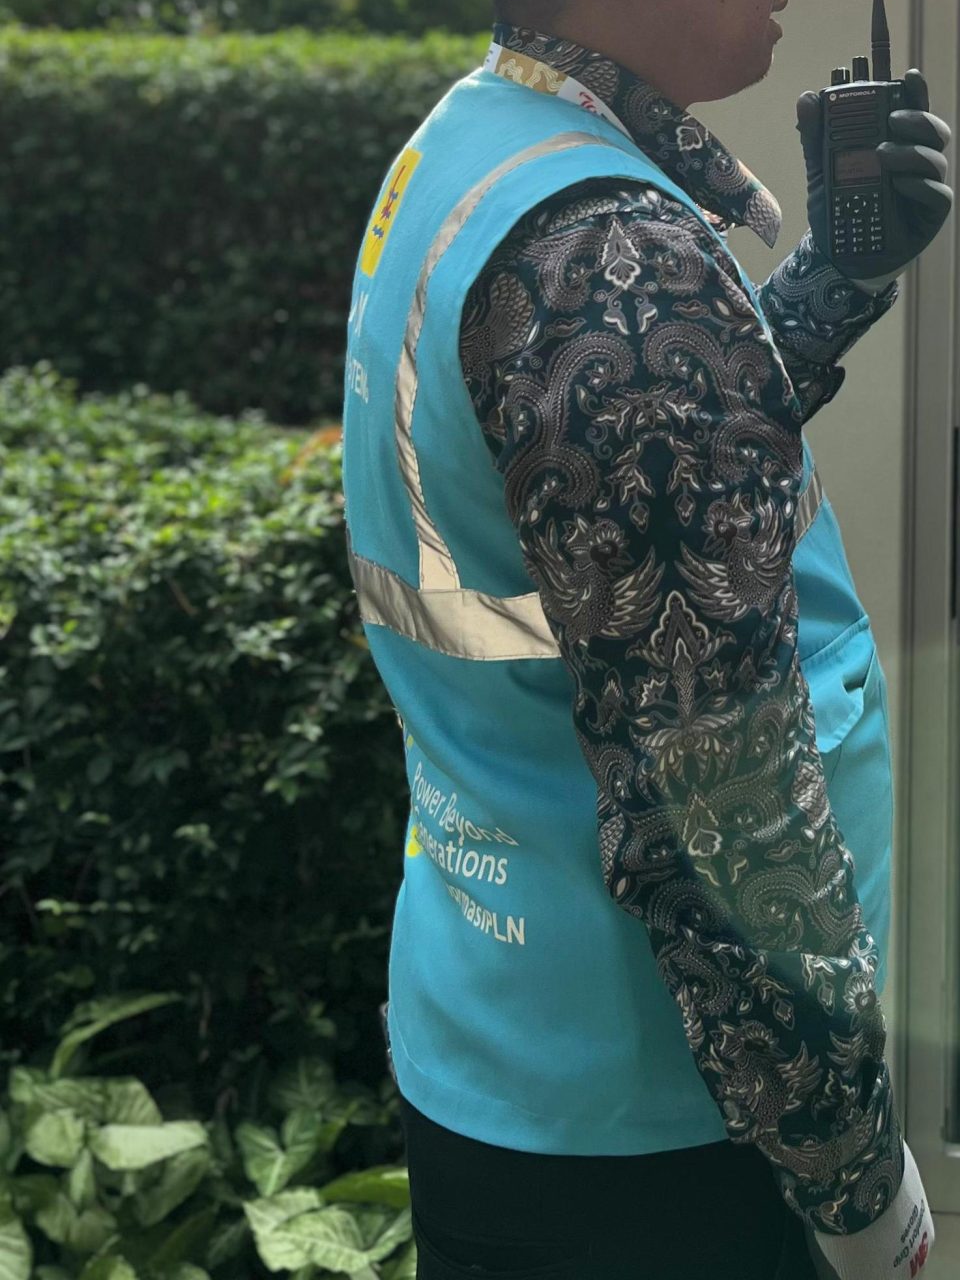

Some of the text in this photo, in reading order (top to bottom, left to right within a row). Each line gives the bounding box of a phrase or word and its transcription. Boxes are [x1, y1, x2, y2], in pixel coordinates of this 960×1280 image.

[839, 90, 876, 98] MOTOROLA
[412, 761, 520, 846] Power Beyond
[901, 1204, 918, 1243] Gloves
[893, 1246, 909, 1268] Grip
